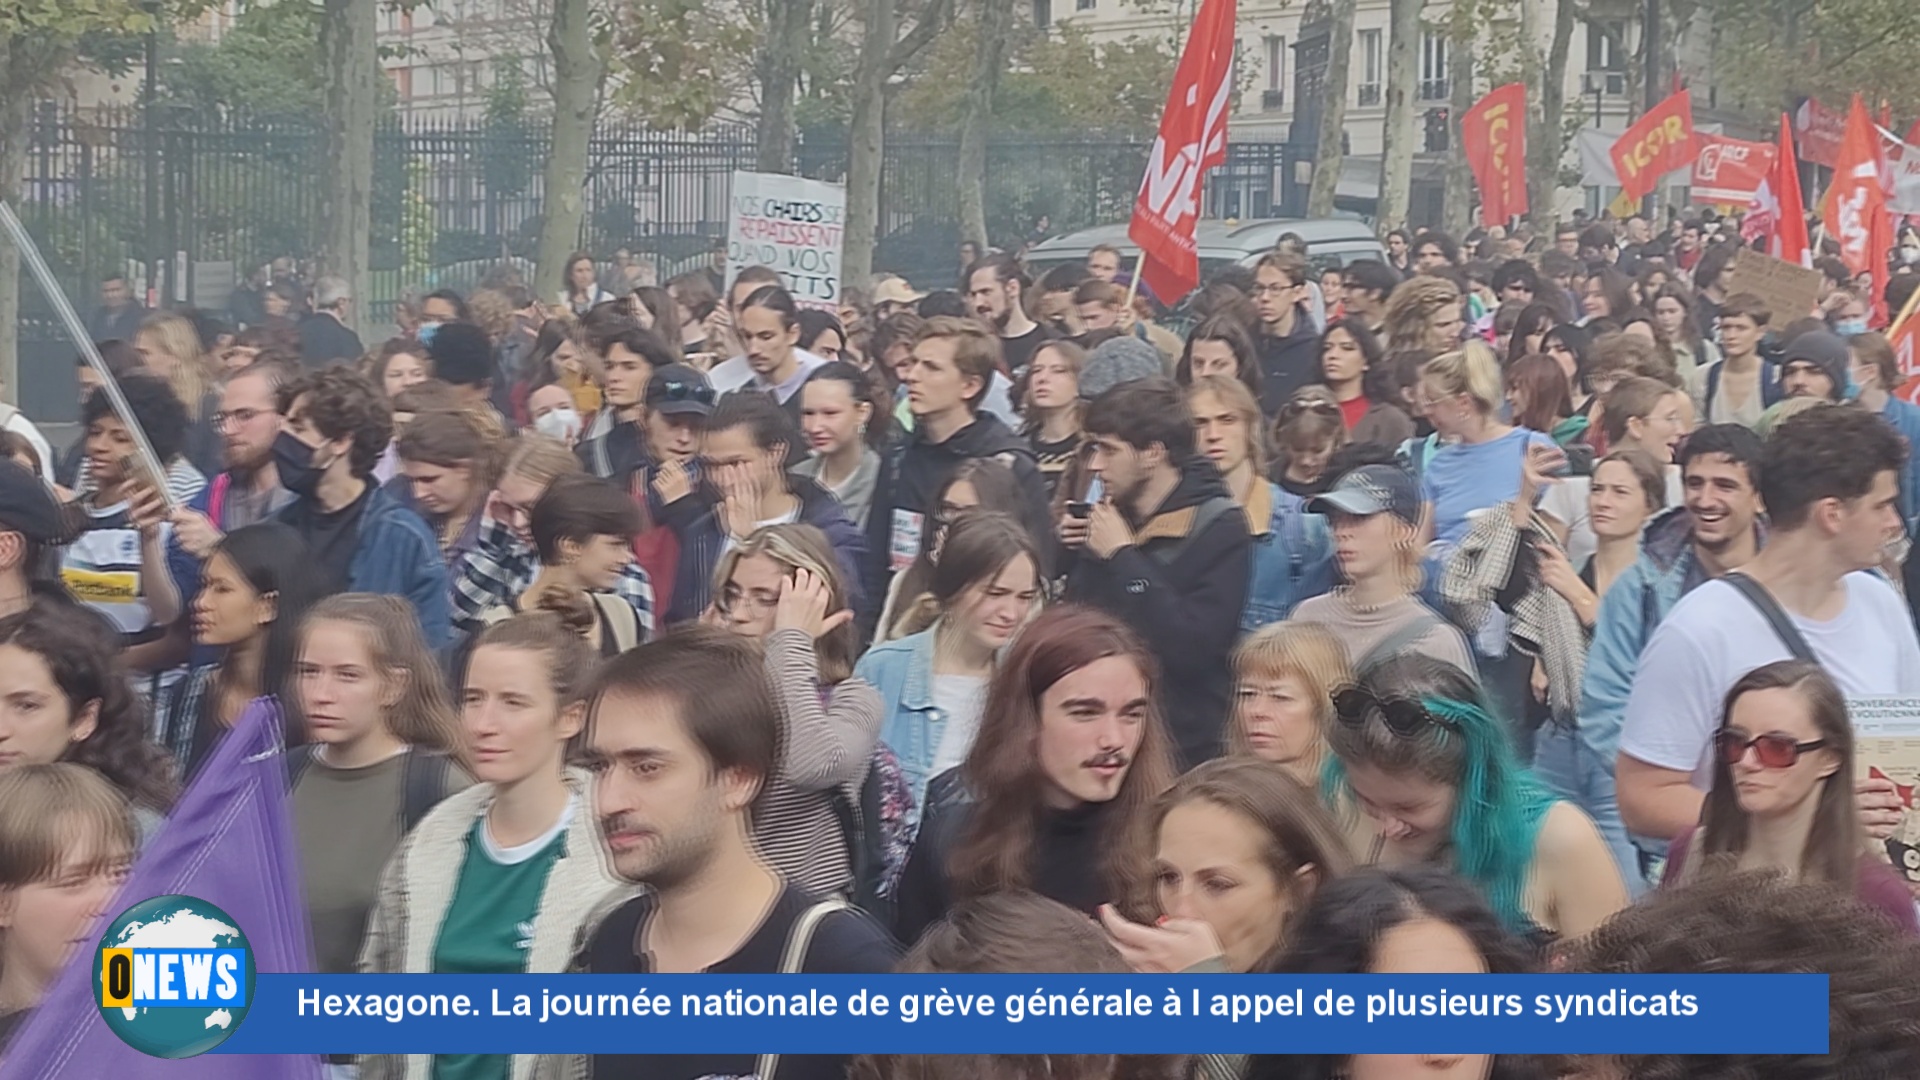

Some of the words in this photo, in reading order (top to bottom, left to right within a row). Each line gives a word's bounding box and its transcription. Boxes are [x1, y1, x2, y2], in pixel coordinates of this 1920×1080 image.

[1622, 115, 1688, 178] ICOR
[763, 198, 822, 222] CHAIRS
[822, 205, 842, 225] SE
[738, 216, 842, 247] REPAISSENT
[788, 248, 835, 275] VOS
